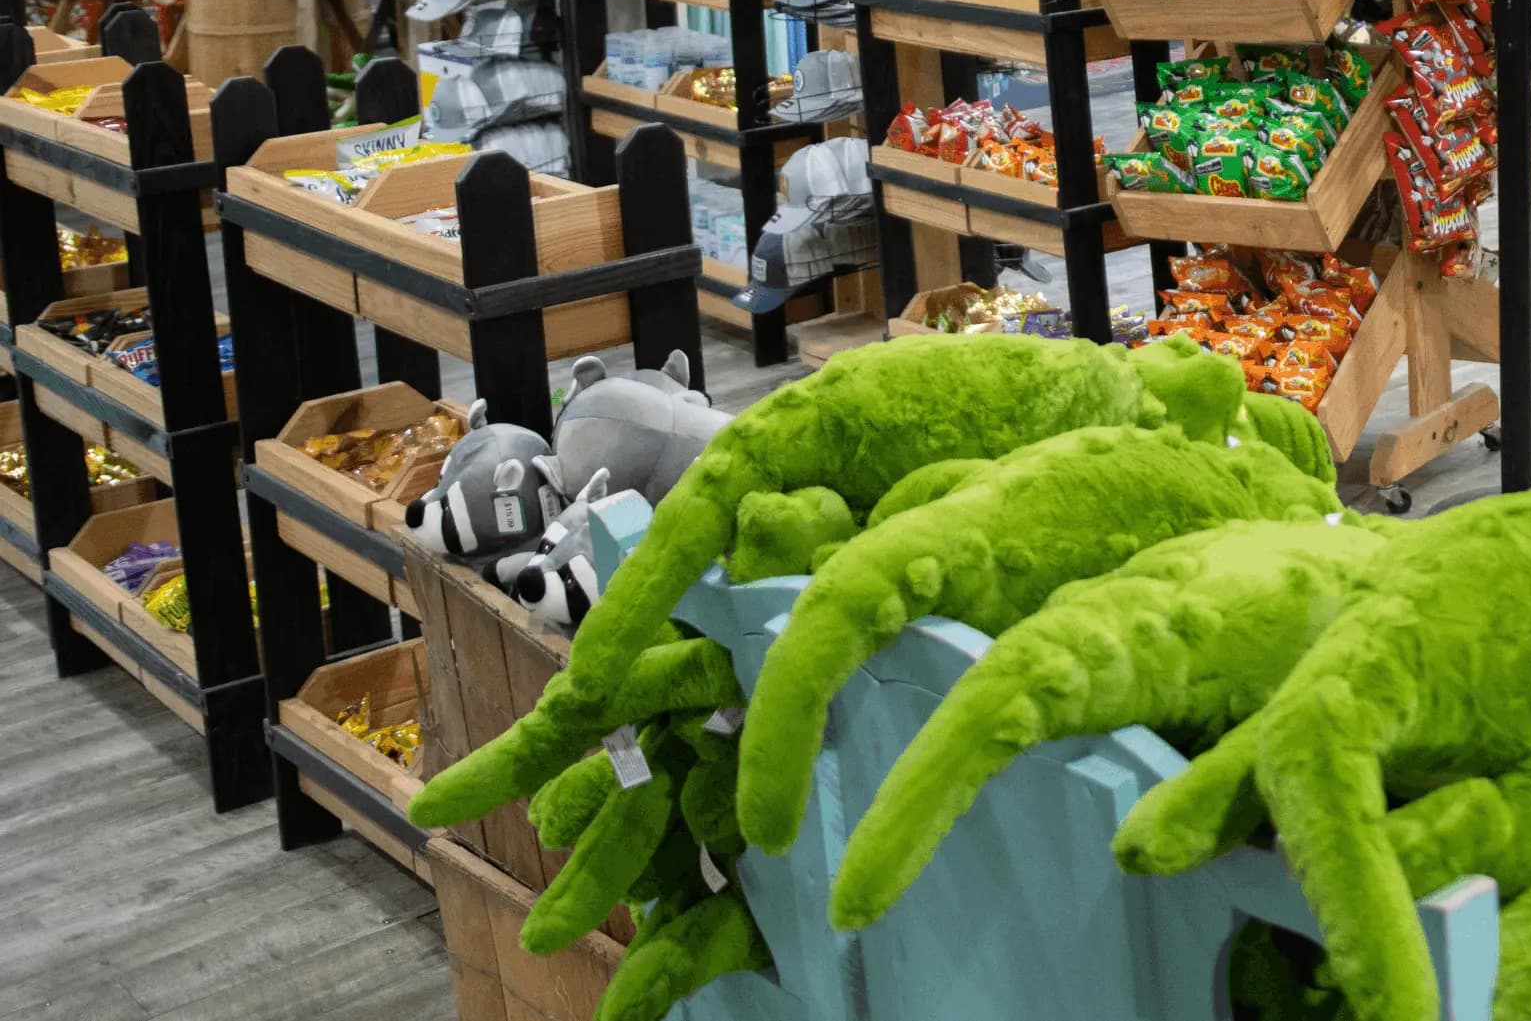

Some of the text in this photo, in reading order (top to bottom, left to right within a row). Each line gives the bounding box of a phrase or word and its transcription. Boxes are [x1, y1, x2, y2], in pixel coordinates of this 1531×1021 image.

[1445, 76, 1482, 102] Popcorn
[354, 132, 405, 156] SKINNY
[1449, 137, 1485, 171] Popcorn
[1432, 208, 1467, 235] Popcorn
